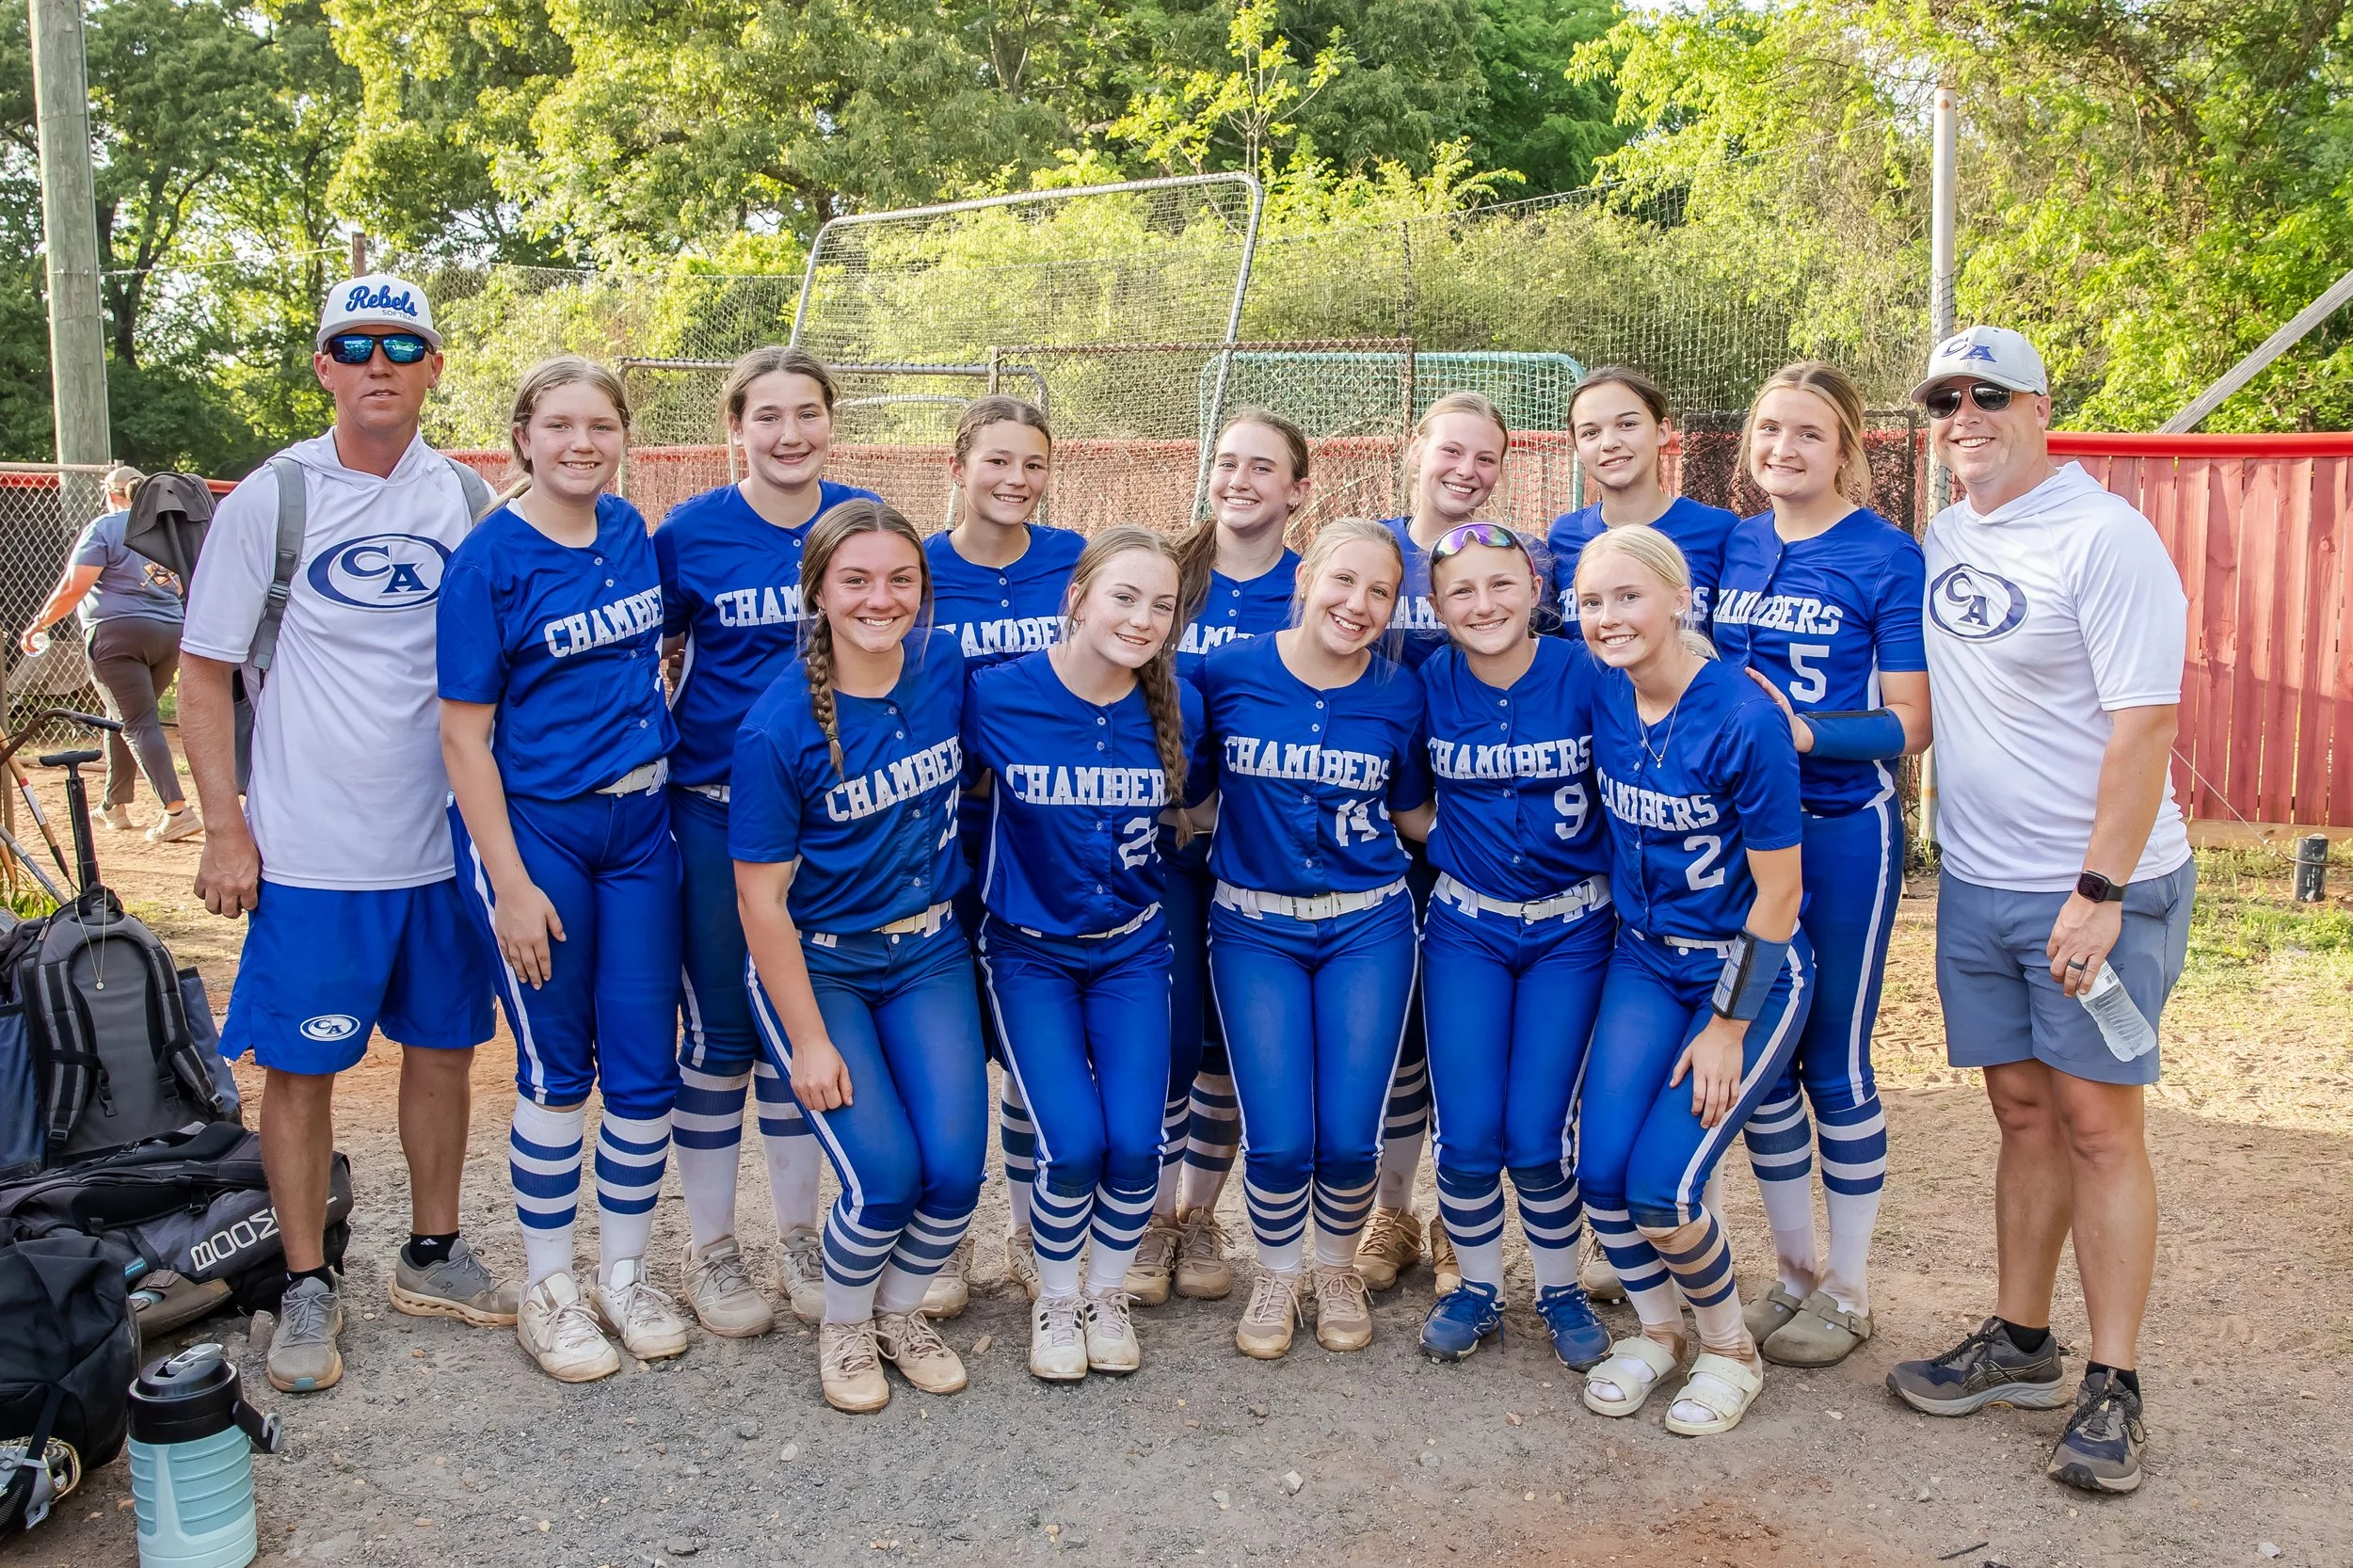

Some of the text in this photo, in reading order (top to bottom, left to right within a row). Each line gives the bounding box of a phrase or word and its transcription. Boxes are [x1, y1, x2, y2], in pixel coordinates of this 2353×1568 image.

[345, 285, 419, 316] Rebels
[1942, 337, 1996, 362] CA
[340, 545, 431, 596] CA
[714, 584, 818, 628] CHAM
[1945, 571, 1991, 628] CA
[1789, 642, 1831, 704] 5
[1224, 735, 1390, 792] CHAMBERS
[1427, 734, 1593, 779] CHAMBERS
[1006, 763, 1172, 807] CHAMBER
[1335, 797, 1380, 847] 14
[1554, 782, 1589, 840] 9
[1683, 835, 1726, 891] 2
[190, 1206, 280, 1272] BOOM
